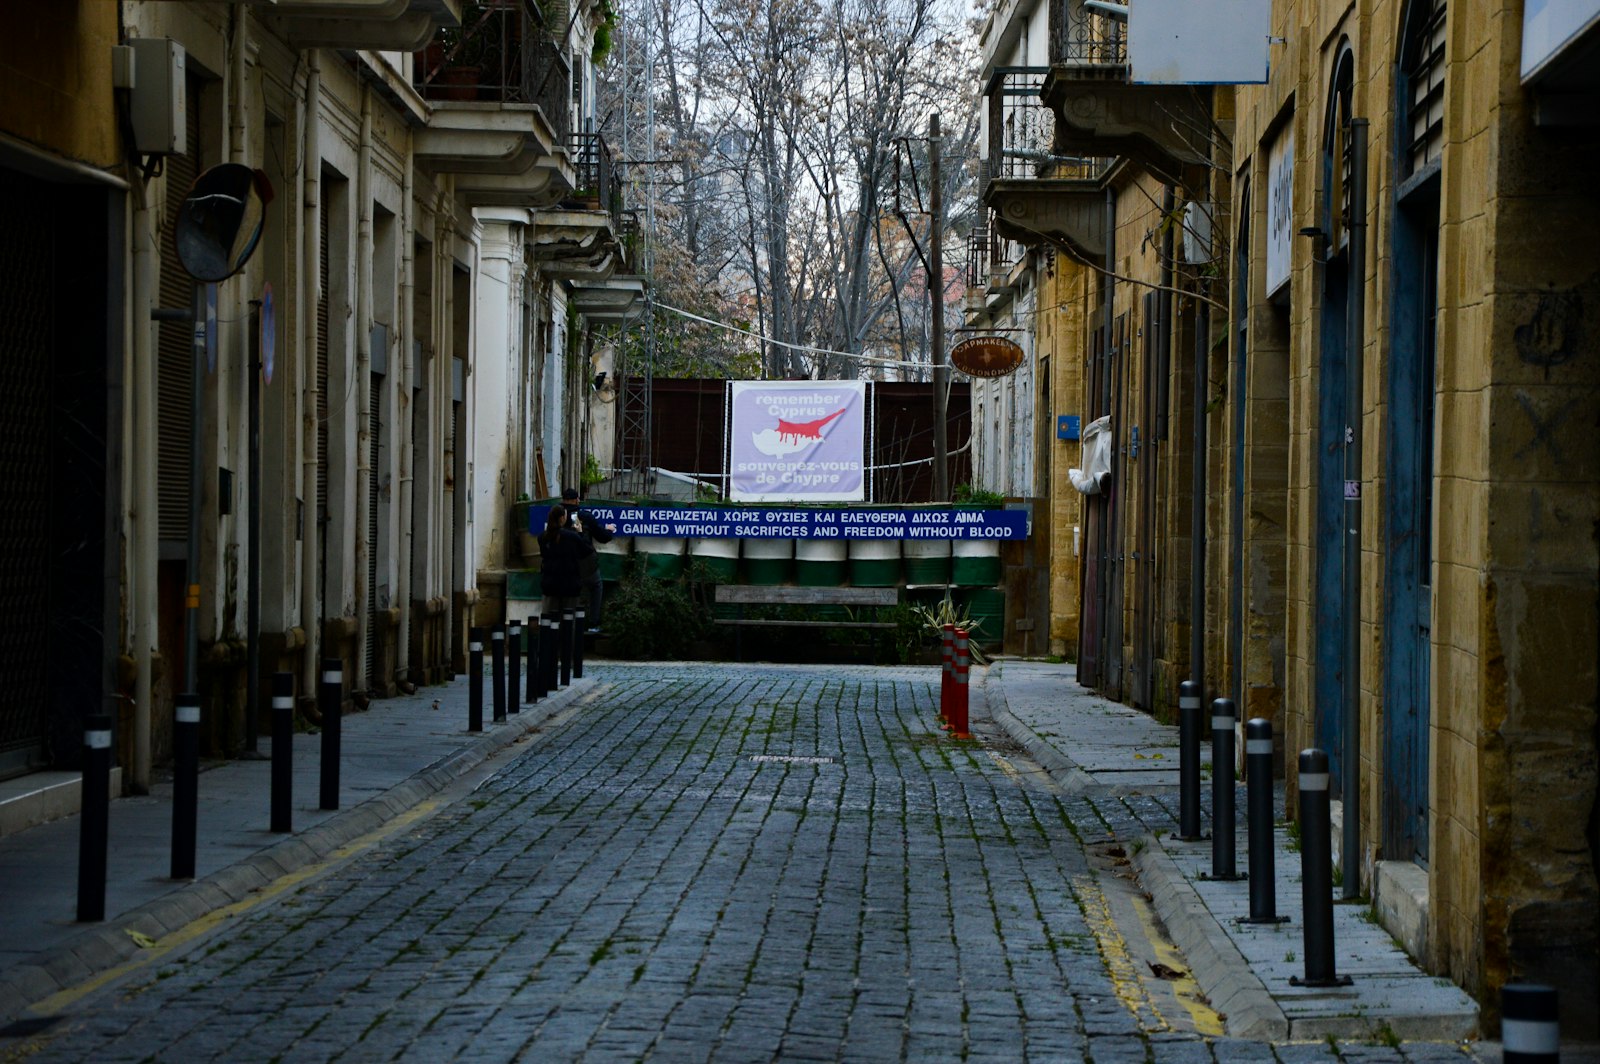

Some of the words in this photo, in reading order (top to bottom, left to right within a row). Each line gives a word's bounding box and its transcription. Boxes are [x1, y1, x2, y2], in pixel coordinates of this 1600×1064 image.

[755, 393, 841, 405] remember
[767, 405, 826, 418] Cyprus
[737, 461, 859, 472] souvenez-vous
[755, 472, 776, 484] de
[781, 472, 840, 486] Chypre
[619, 509, 644, 521] ΔΕΝ
[650, 510, 718, 522] ΚΕΡΔΙΖΕΤΑΙ
[723, 511, 760, 522] ΧΩΡΙΣ
[766, 512, 808, 523] ΘΥΣΙΕΣ
[814, 512, 835, 523] ΚΑΙ
[841, 512, 907, 523] ΕΛΕΥΘΕΡΙΑ
[912, 512, 948, 523] ΔΙΧΩΣ
[622, 523, 670, 535] GAINED
[674, 524, 730, 536] WITHOUT
[735, 525, 809, 537] SACRIFICES
[813, 526, 838, 537] AND
[845, 526, 904, 538] FREEDOM
[909, 526, 964, 538] WITHOUT
[969, 526, 1013, 538] BLOOD
